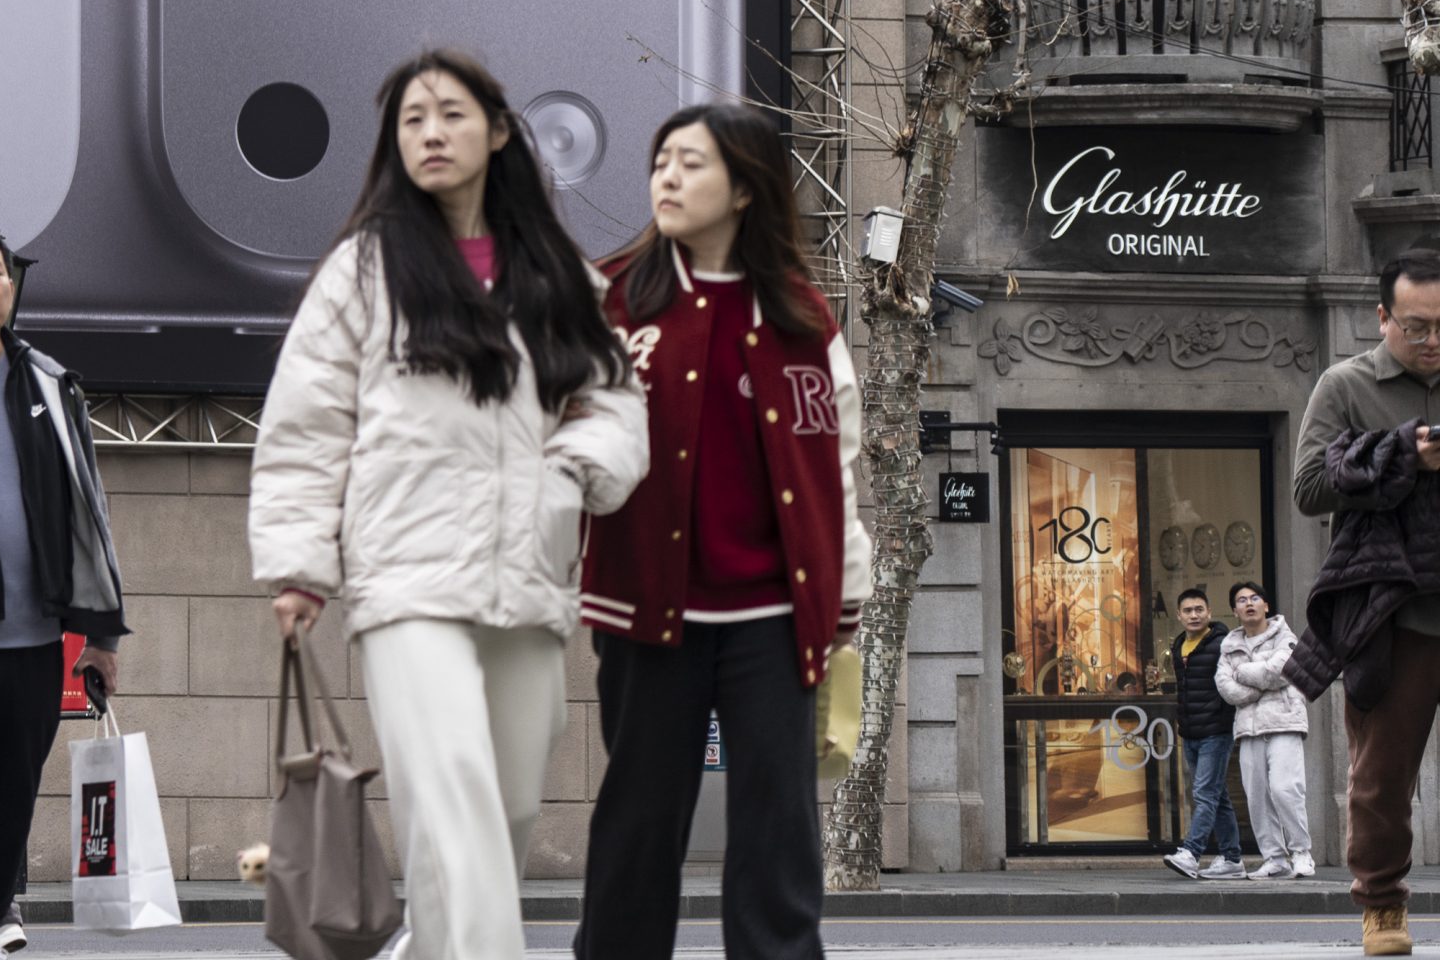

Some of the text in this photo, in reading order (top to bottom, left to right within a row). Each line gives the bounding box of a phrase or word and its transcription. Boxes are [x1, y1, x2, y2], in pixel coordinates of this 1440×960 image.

[1042, 146, 1263, 240] Glashütte
[1109, 233, 1210, 257] ORIGINAL
[1088, 705, 1174, 771] 180
[85, 837, 108, 856] SALE
